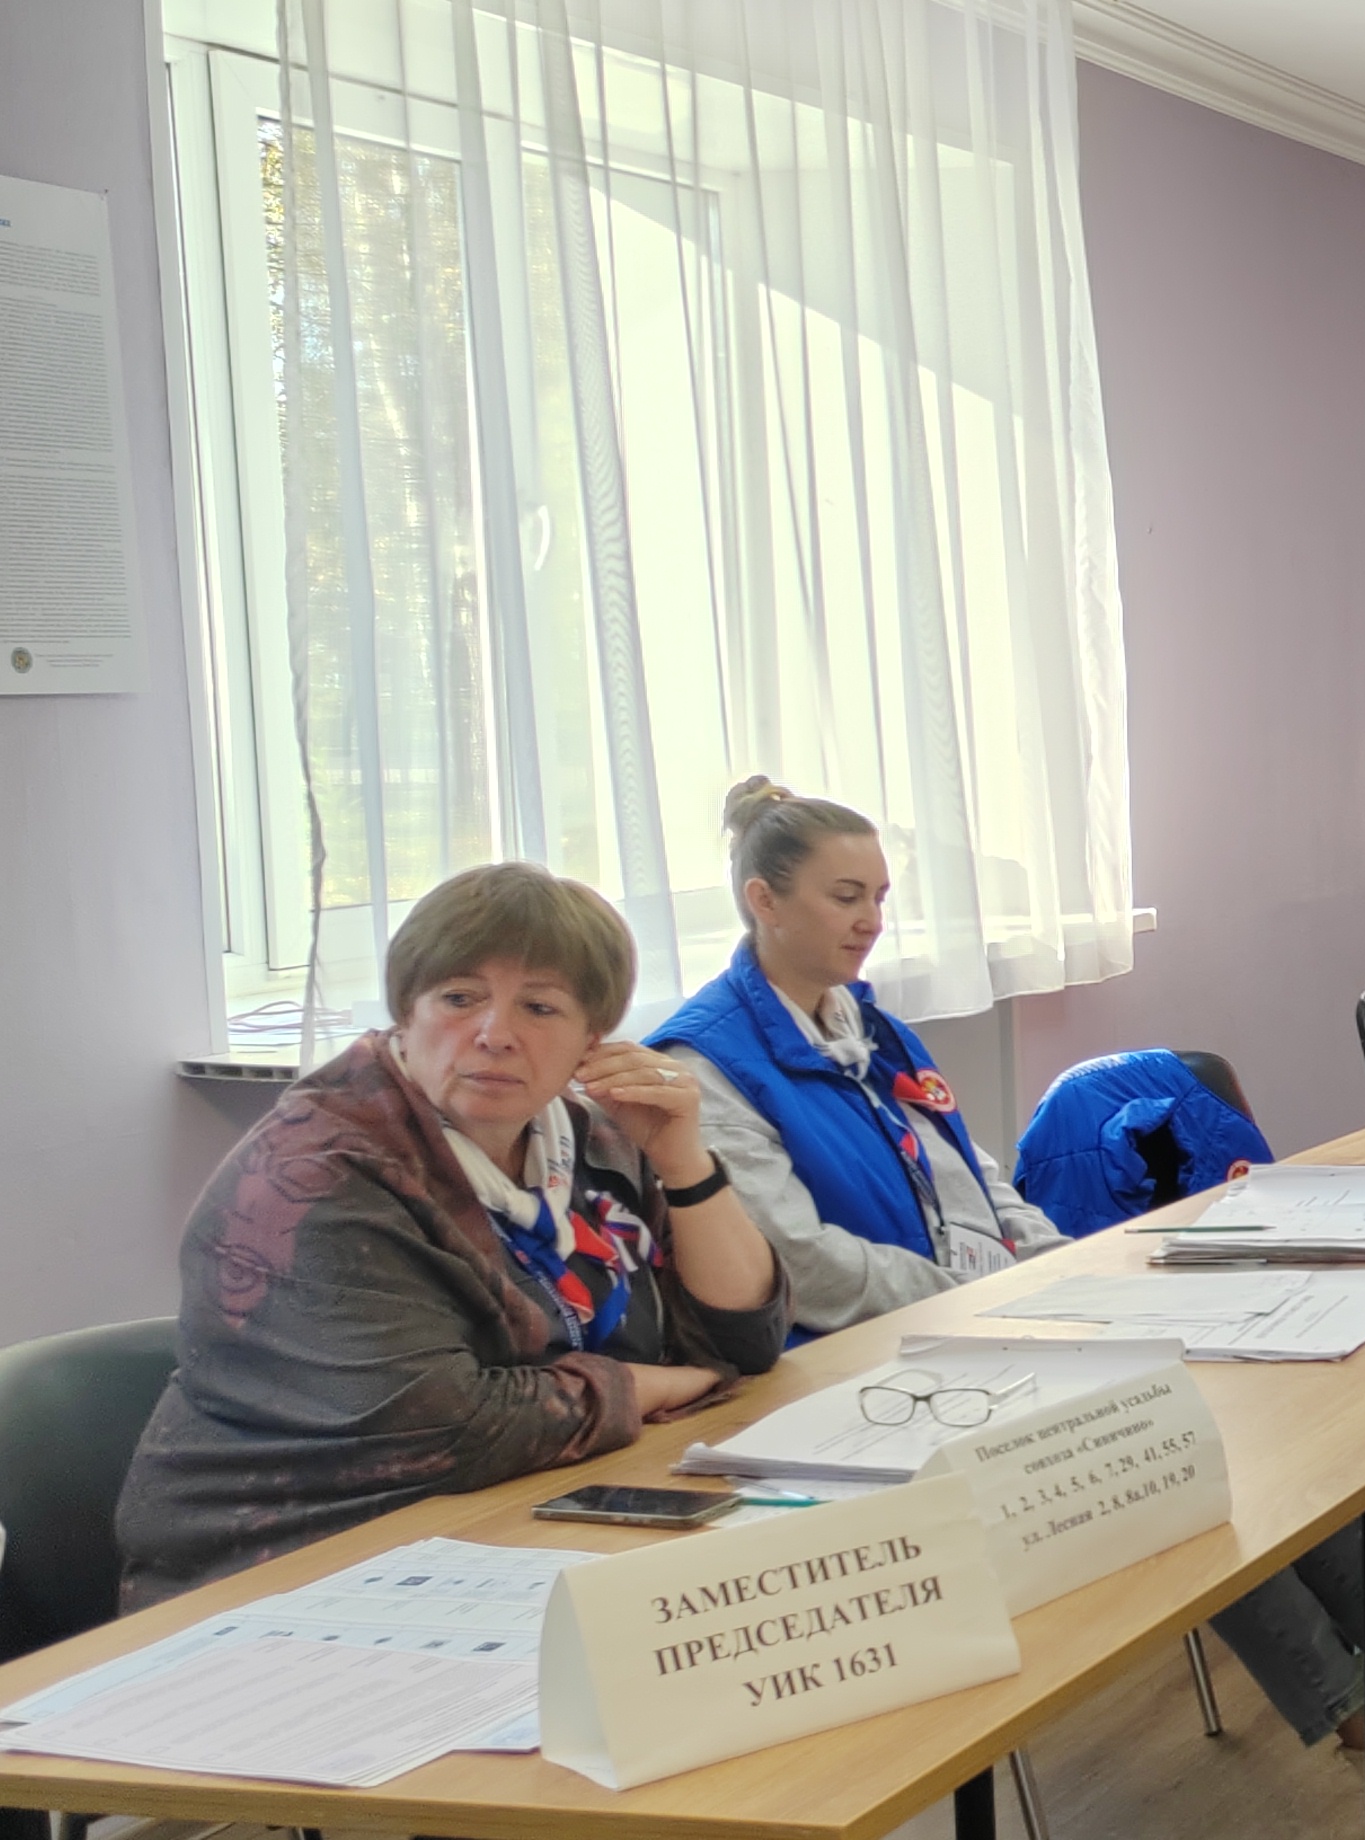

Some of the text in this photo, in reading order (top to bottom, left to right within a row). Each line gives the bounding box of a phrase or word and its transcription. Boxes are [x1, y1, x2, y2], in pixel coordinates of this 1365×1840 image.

[975, 1384, 1172, 1462] Поселок центральной усадьбы
[1019, 1496, 1035, 1512] 2,
[1181, 1430, 1196, 1449] 57
[1181, 1464, 1196, 1482] 20
[651, 1535, 922, 1624] ЗАМЕСТИТЕЛЬ
[654, 1575, 943, 1676] ПРЕДСЕДАТЕЛЯ
[743, 1642, 899, 1707] УИК 1631
